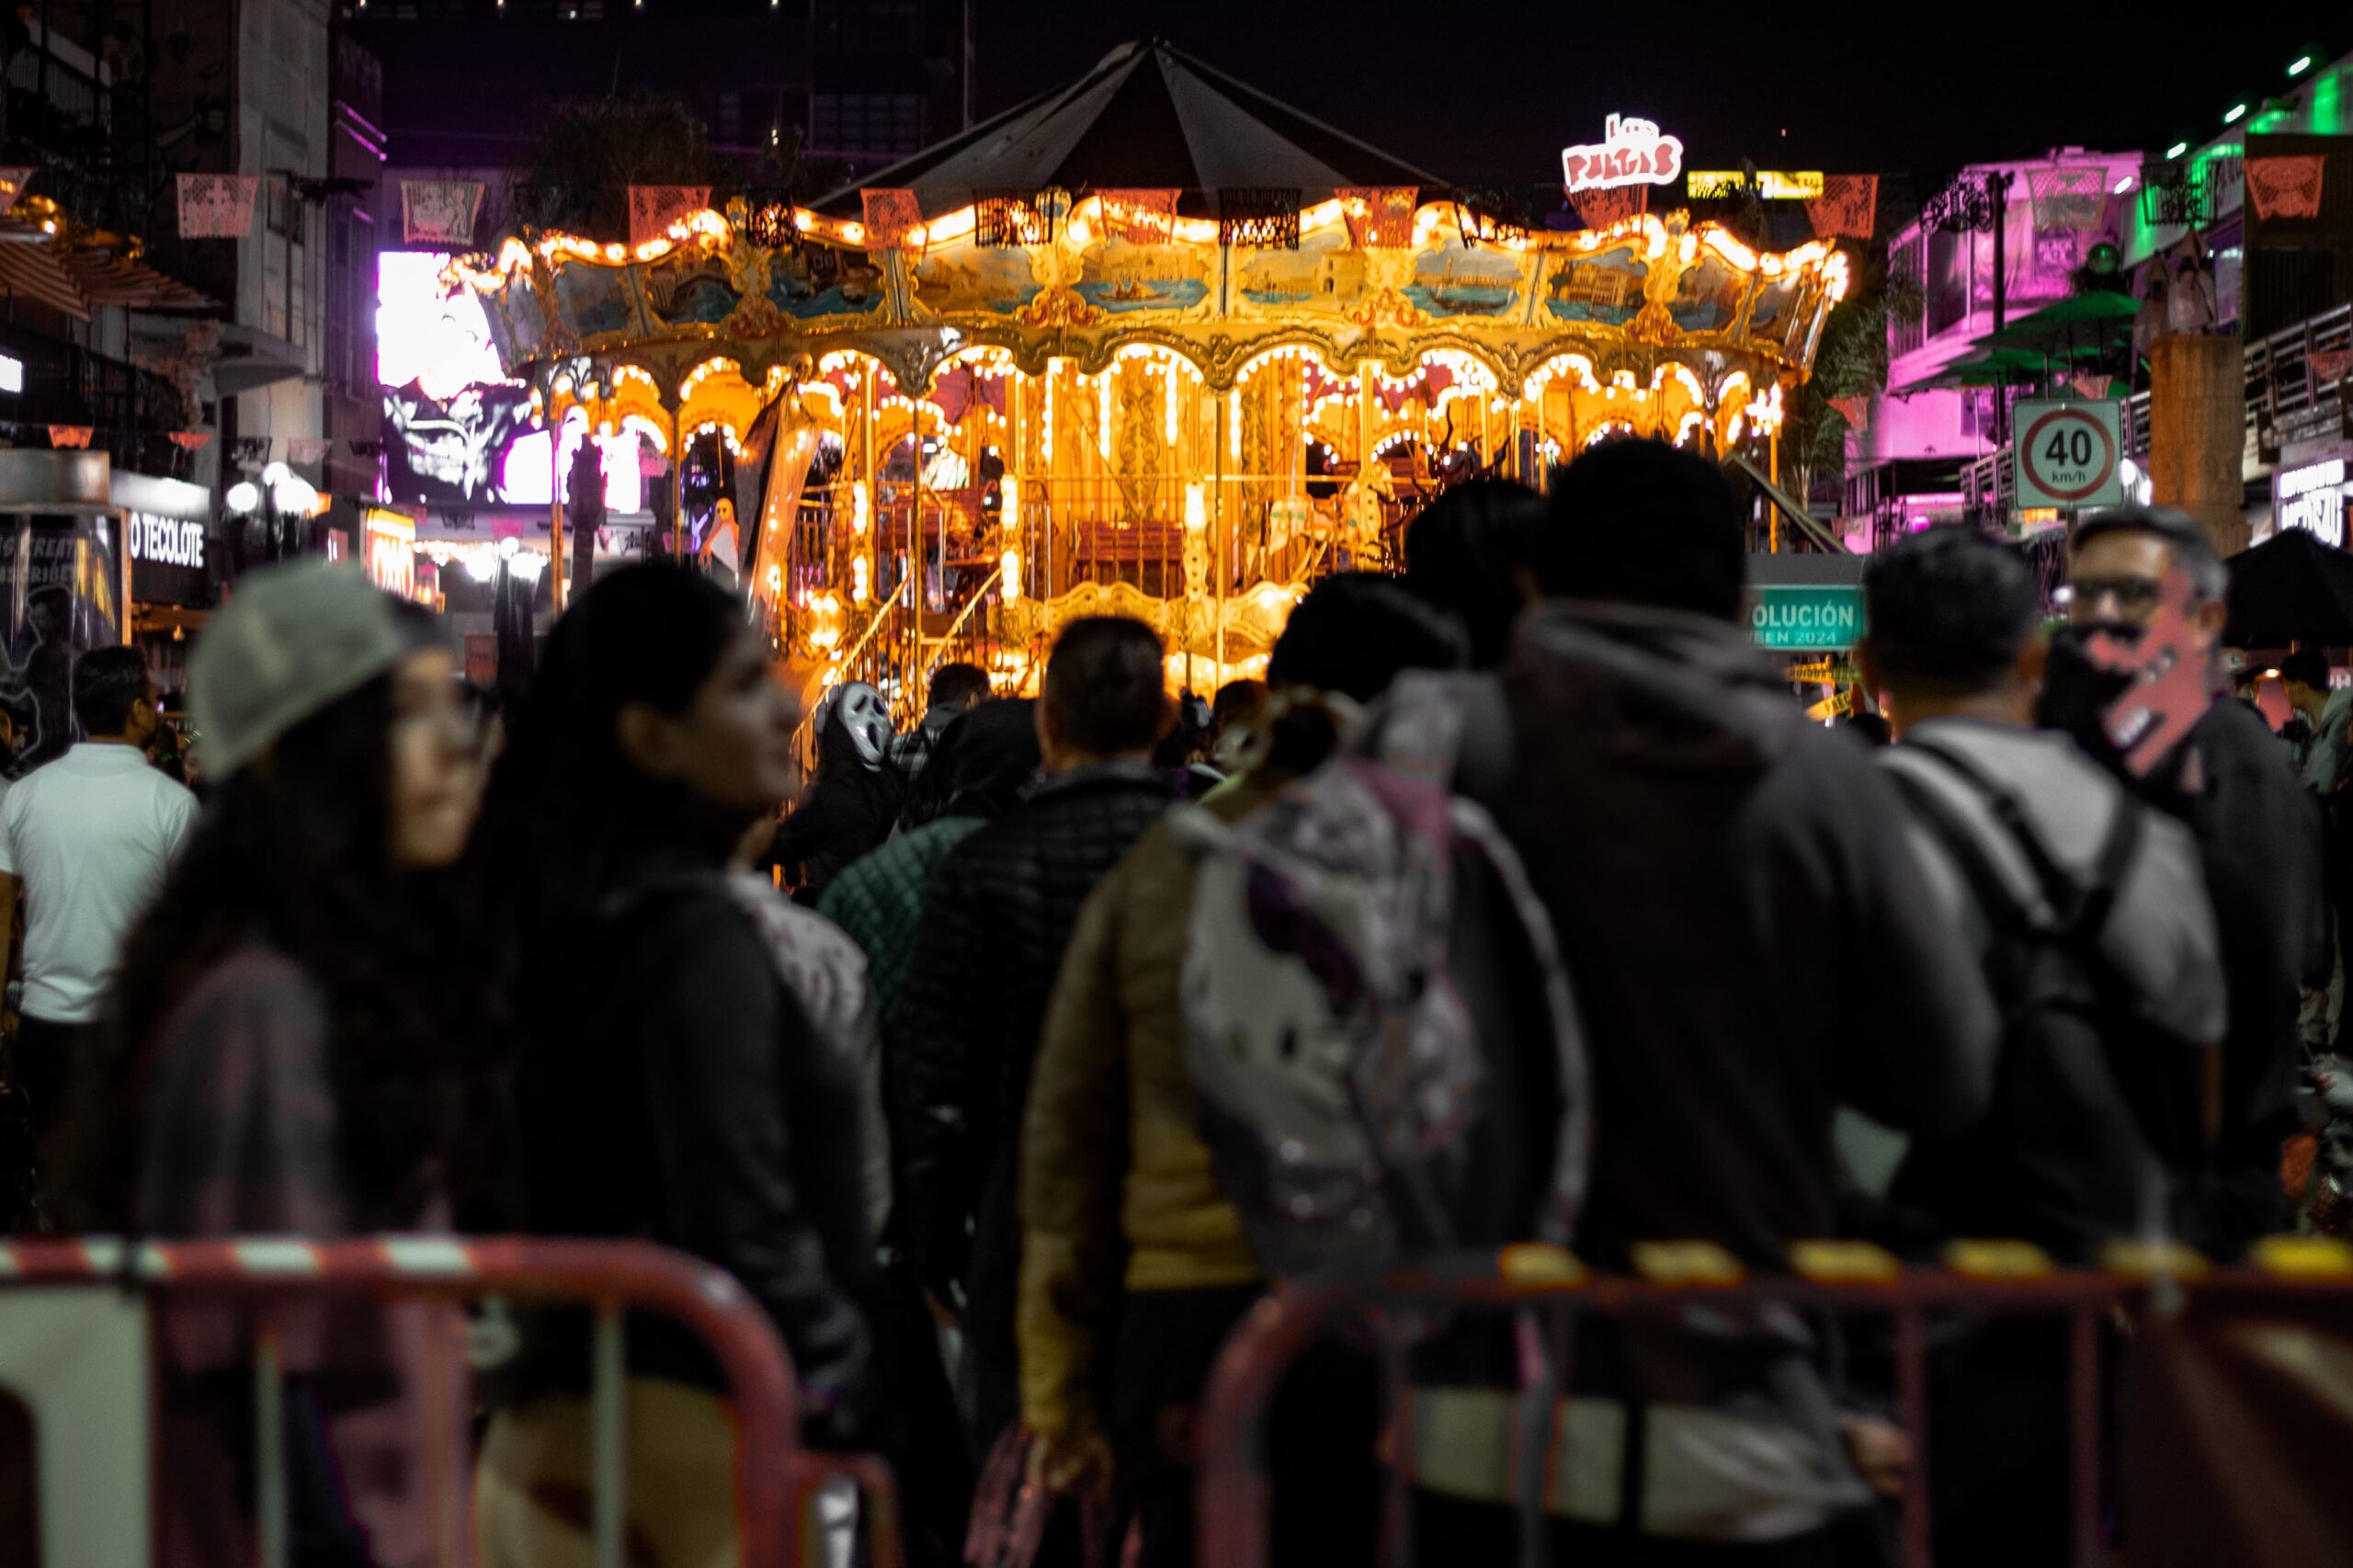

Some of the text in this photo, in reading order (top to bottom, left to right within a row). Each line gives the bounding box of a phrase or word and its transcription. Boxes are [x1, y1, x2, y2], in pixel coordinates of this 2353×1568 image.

[1564, 141, 1678, 187] PULGAS
[2045, 428, 2092, 466] 40
[2052, 470, 2086, 483] km/h
[142, 513, 205, 568] TECOLOTE
[1795, 631, 1836, 644] 2024
